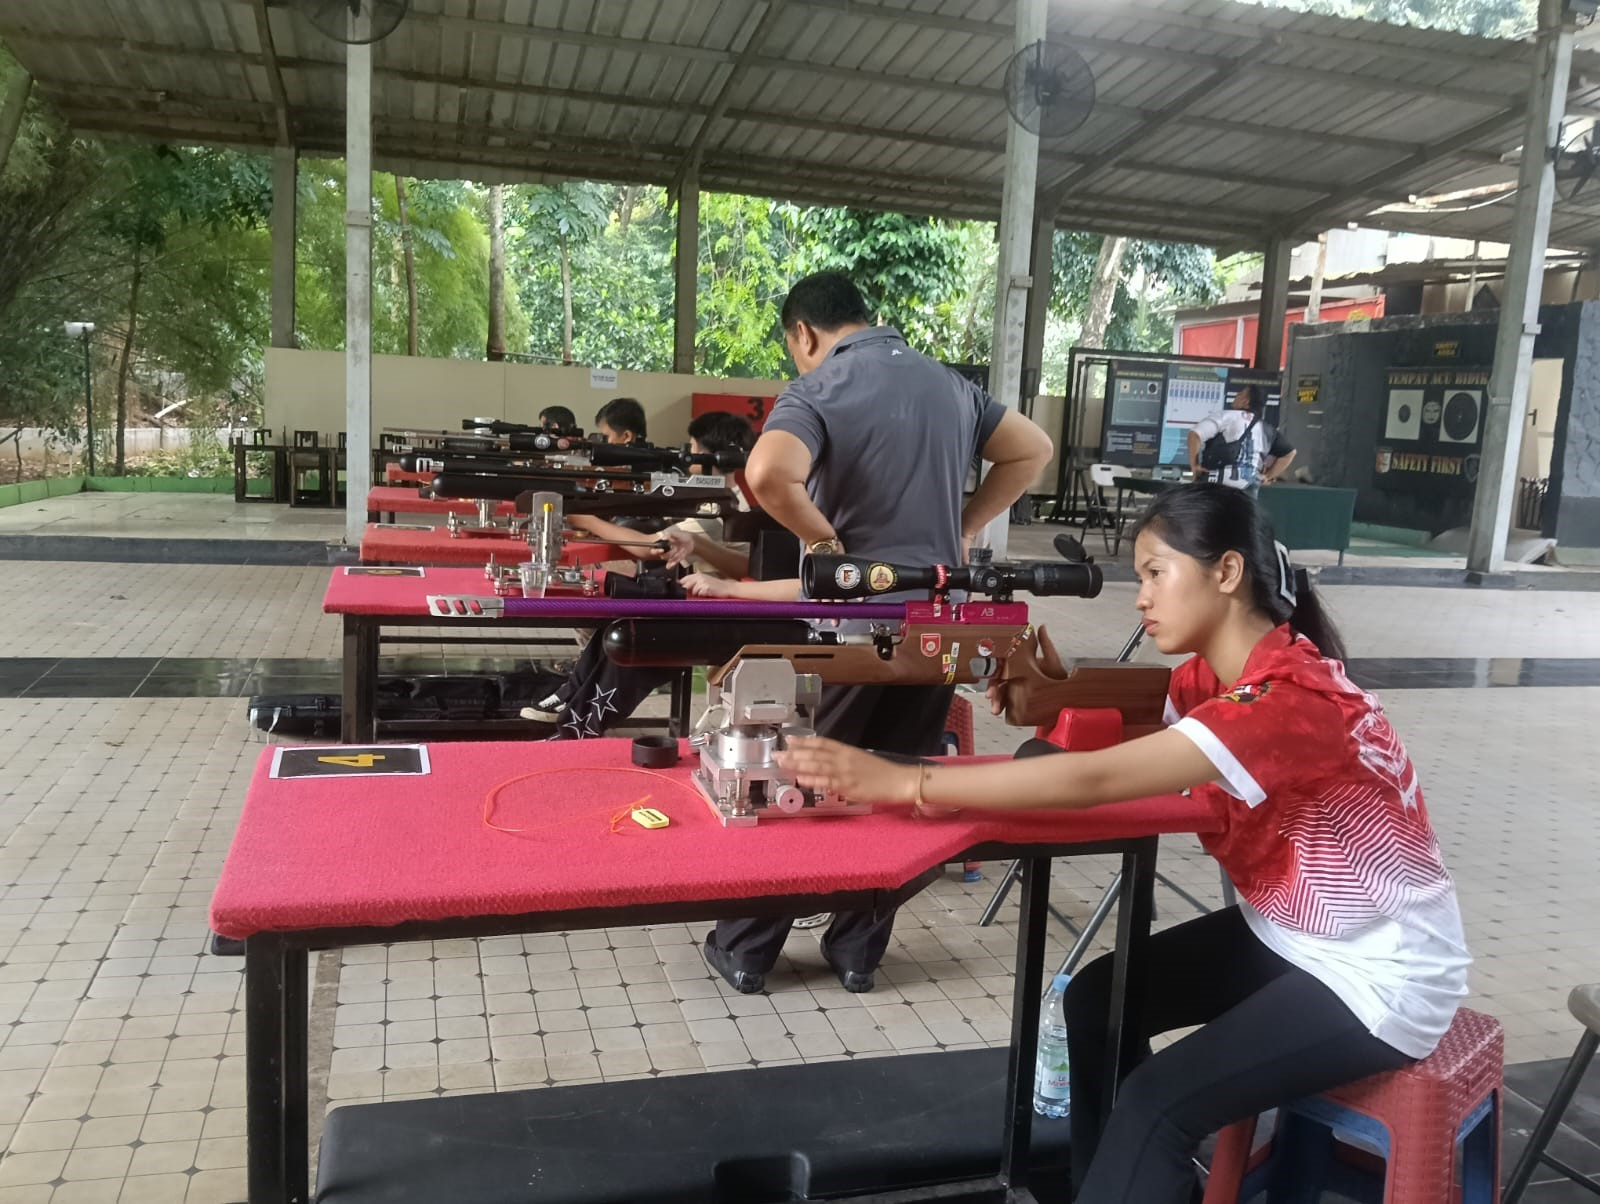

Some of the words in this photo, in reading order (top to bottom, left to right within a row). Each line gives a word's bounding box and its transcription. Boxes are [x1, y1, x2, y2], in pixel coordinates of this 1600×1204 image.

[1388, 371, 1428, 384] TEMPAT
[1430, 371, 1451, 384] ACU
[1455, 371, 1488, 384] BIDIK
[747, 397, 763, 419] 3
[1392, 453, 1428, 472] SAFETY
[1431, 455, 1463, 475] FIRST
[317, 754, 385, 767] 4
